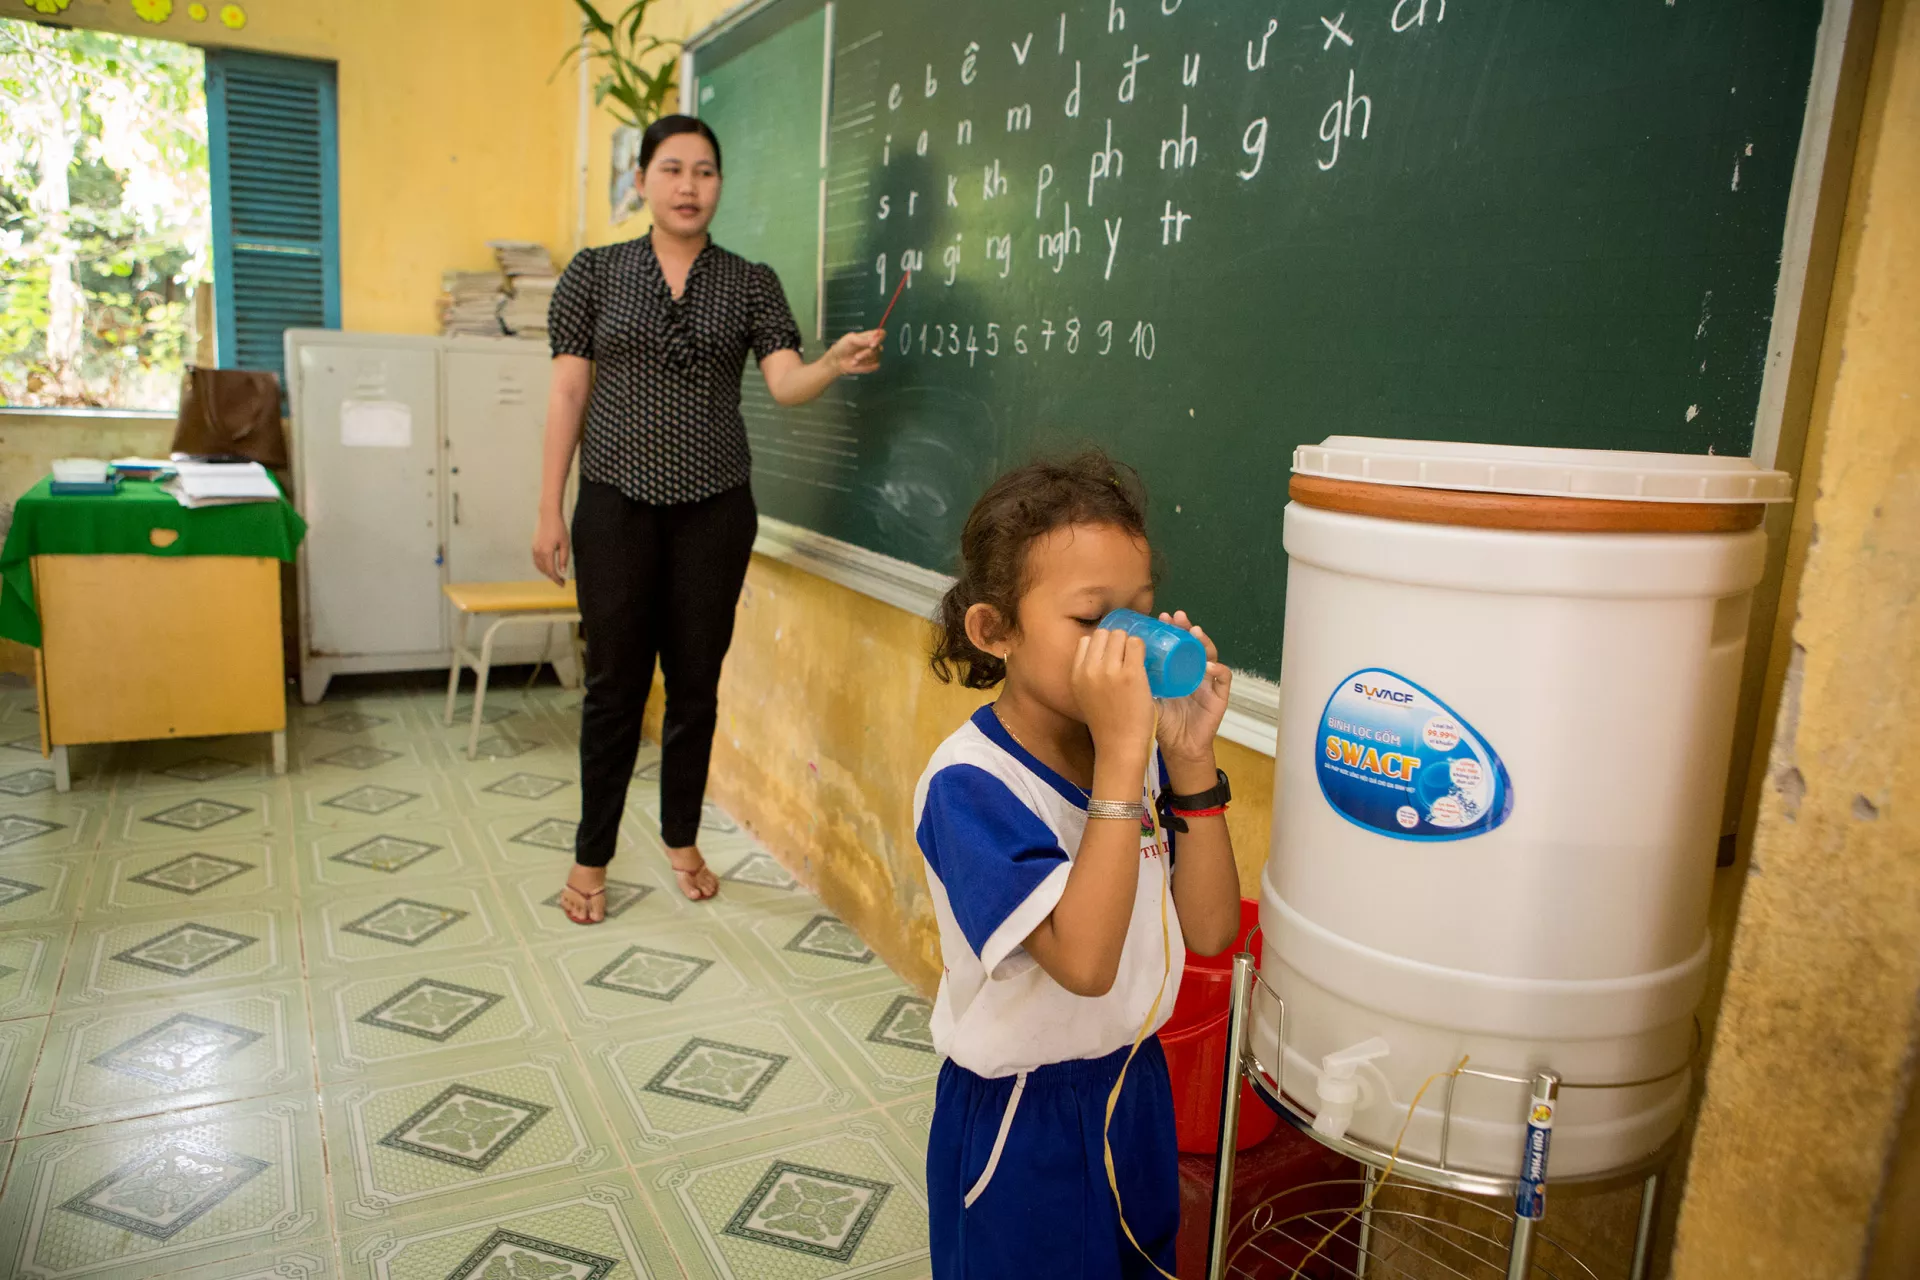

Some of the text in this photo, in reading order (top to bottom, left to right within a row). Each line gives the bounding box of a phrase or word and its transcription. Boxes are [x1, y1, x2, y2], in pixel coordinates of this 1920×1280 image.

[883, 134, 892, 166] i
[916, 129, 929, 156] a
[957, 119, 972, 145] n
[1006, 103, 1032, 132] m
[1065, 60, 1081, 118] d
[1118, 44, 1150, 103] đ
[1182, 54, 1200, 87] u
[1247, 18, 1278, 71] ư
[1320, 12, 1354, 50] x
[888, 83, 902, 110] e
[925, 63, 938, 97] b
[960, 41, 980, 85] ê
[1012, 32, 1033, 65] v
[1108, 0, 1126, 33] h
[877, 195, 890, 220] s
[908, 190, 919, 217] r
[1036, 163, 1054, 219] p
[1087, 118, 1124, 207] ph
[1160, 104, 1198, 169] nh
[1237, 116, 1268, 180] g
[1317, 68, 1372, 171] gh
[876, 199, 1192, 296] q qu gi ng ngh y tr
[1014, 324, 1028, 354] 6
[1065, 317, 1081, 355] 8
[1097, 320, 1113, 355] 9
[1128, 320, 1156, 360] 10
[1325, 735, 1421, 782] SWACF
